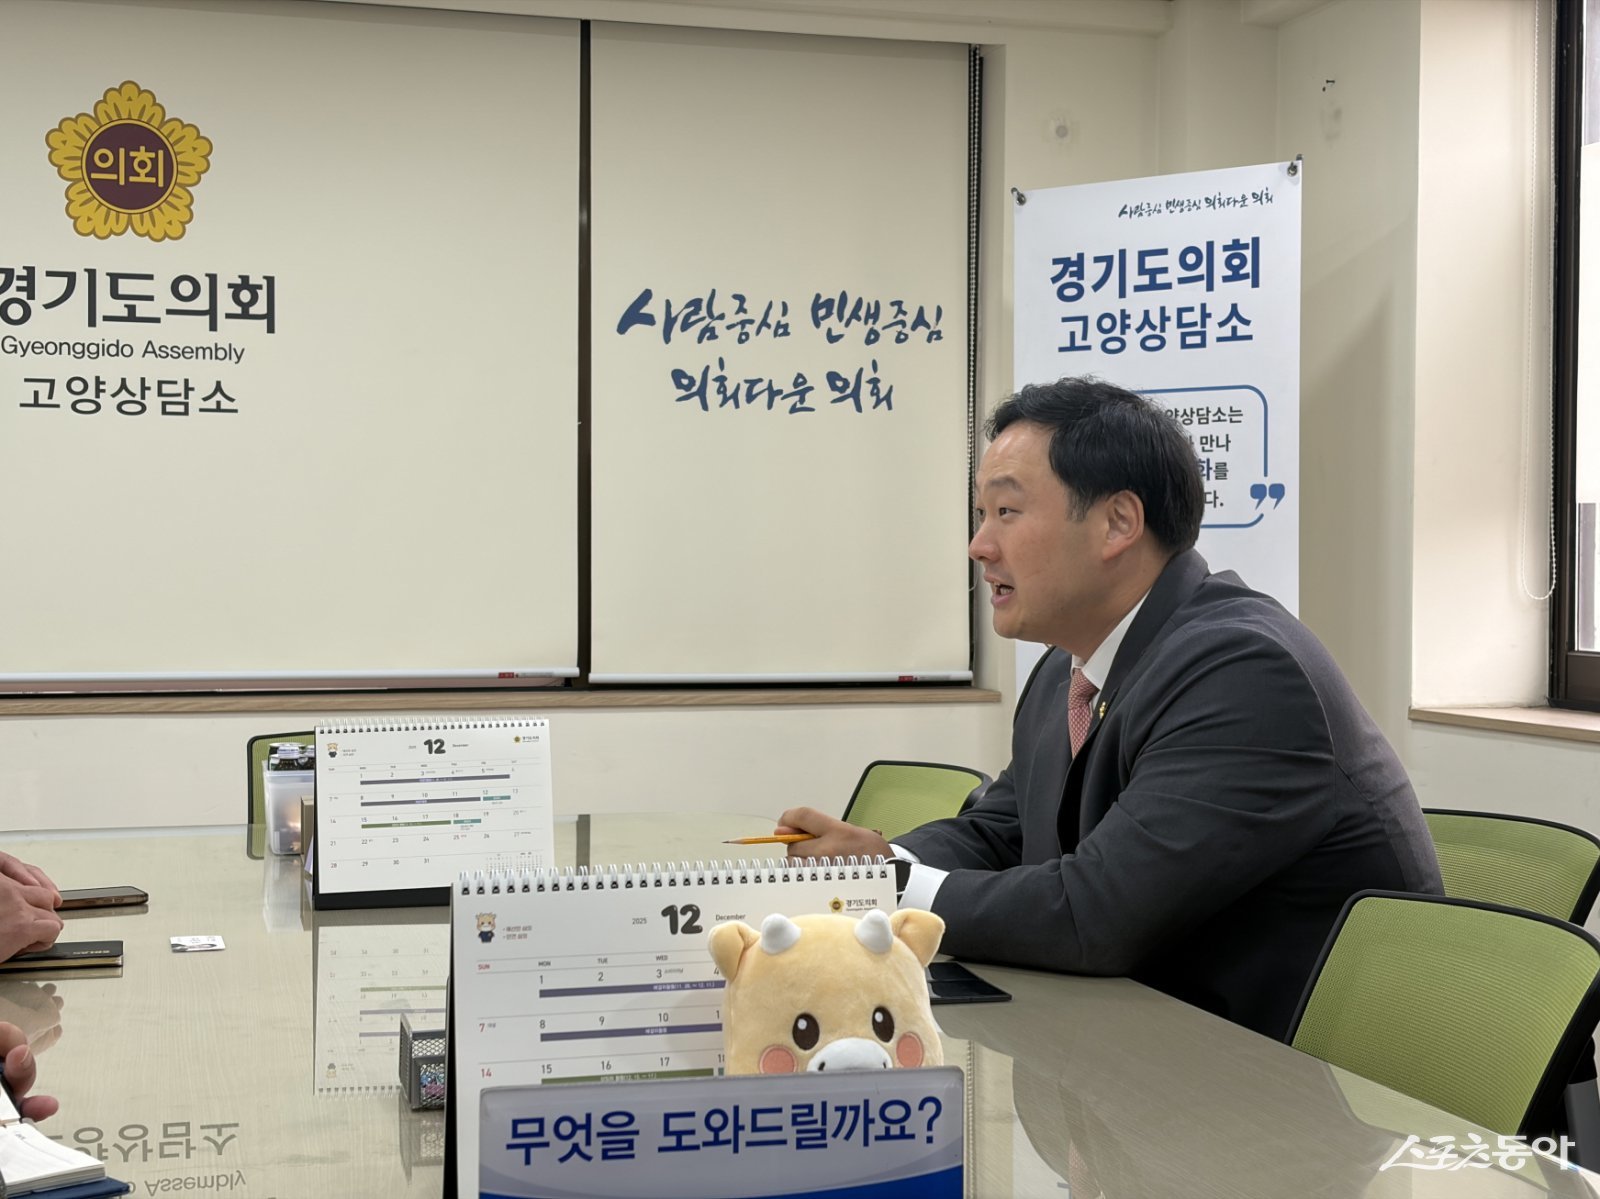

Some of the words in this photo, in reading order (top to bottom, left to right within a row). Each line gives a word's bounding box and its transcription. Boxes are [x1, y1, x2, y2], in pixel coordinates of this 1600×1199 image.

[90, 145, 165, 188] 의회
[1118, 203, 1161, 218] 사람중심
[1166, 199, 1201, 213] 민생중심
[1205, 192, 1248, 210] 의회다운
[1252, 187, 1273, 205] 의회
[1050, 237, 1259, 304] 경기도의회
[0, 265, 276, 334] 경기도의회
[617, 289, 790, 344] 사람중심
[811, 290, 943, 346] 민생중심
[1058, 300, 1253, 354] 고양상담소
[1, 335, 133, 359] Gyeonggido
[142, 340, 245, 364] Assembly
[20, 376, 238, 416] 고양상담소
[671, 357, 815, 414] 의회다운
[826, 359, 893, 413] 의회
[1165, 405, 1244, 426] 양상담소는
[1199, 434, 1231, 453] 만나
[1198, 458, 1229, 481] 화를
[1203, 490, 1225, 509] 다.
[424, 739, 446, 754] 12
[631, 916, 648, 926] 2025
[661, 904, 702, 935] 12
[715, 913, 746, 922] December
[656, 954, 668, 962] WED
[539, 974, 544, 985] 1
[597, 971, 604, 982] 2
[656, 968, 663, 979] 3
[478, 1022, 486, 1033] 7
[539, 1019, 546, 1030] 8
[598, 1015, 605, 1026] 9
[658, 1012, 669, 1023] 10
[481, 1068, 492, 1078] 14
[541, 1063, 553, 1074] 15
[601, 1060, 612, 1071] 16
[659, 1056, 670, 1067] 17
[506, 1111, 639, 1165] 무엇을
[658, 1096, 942, 1154] 도와드릴까요?
